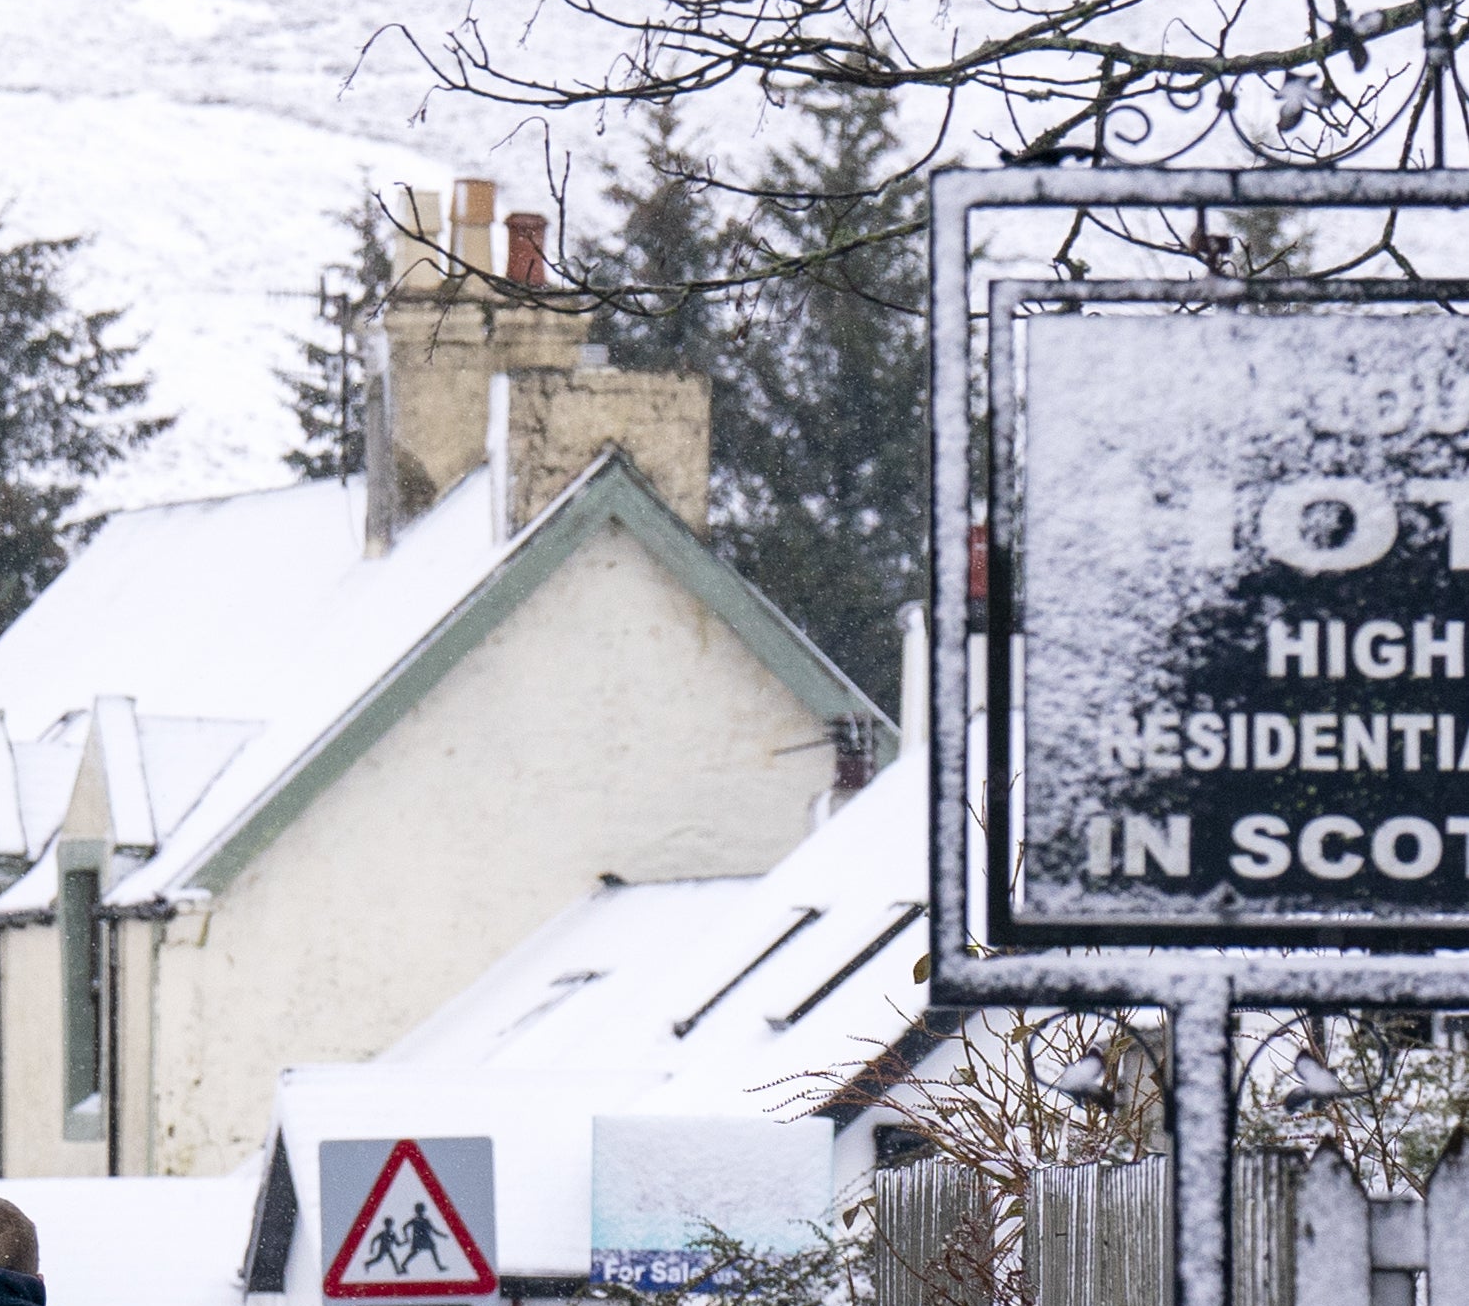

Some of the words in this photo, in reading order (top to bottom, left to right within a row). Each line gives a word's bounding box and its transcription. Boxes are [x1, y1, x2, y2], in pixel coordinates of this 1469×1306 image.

[1266, 619, 1465, 679] HIGH
[1096, 710, 1469, 772] RESIDENTI
[1088, 814, 1192, 877] IN
[603, 1258, 646, 1283] For
